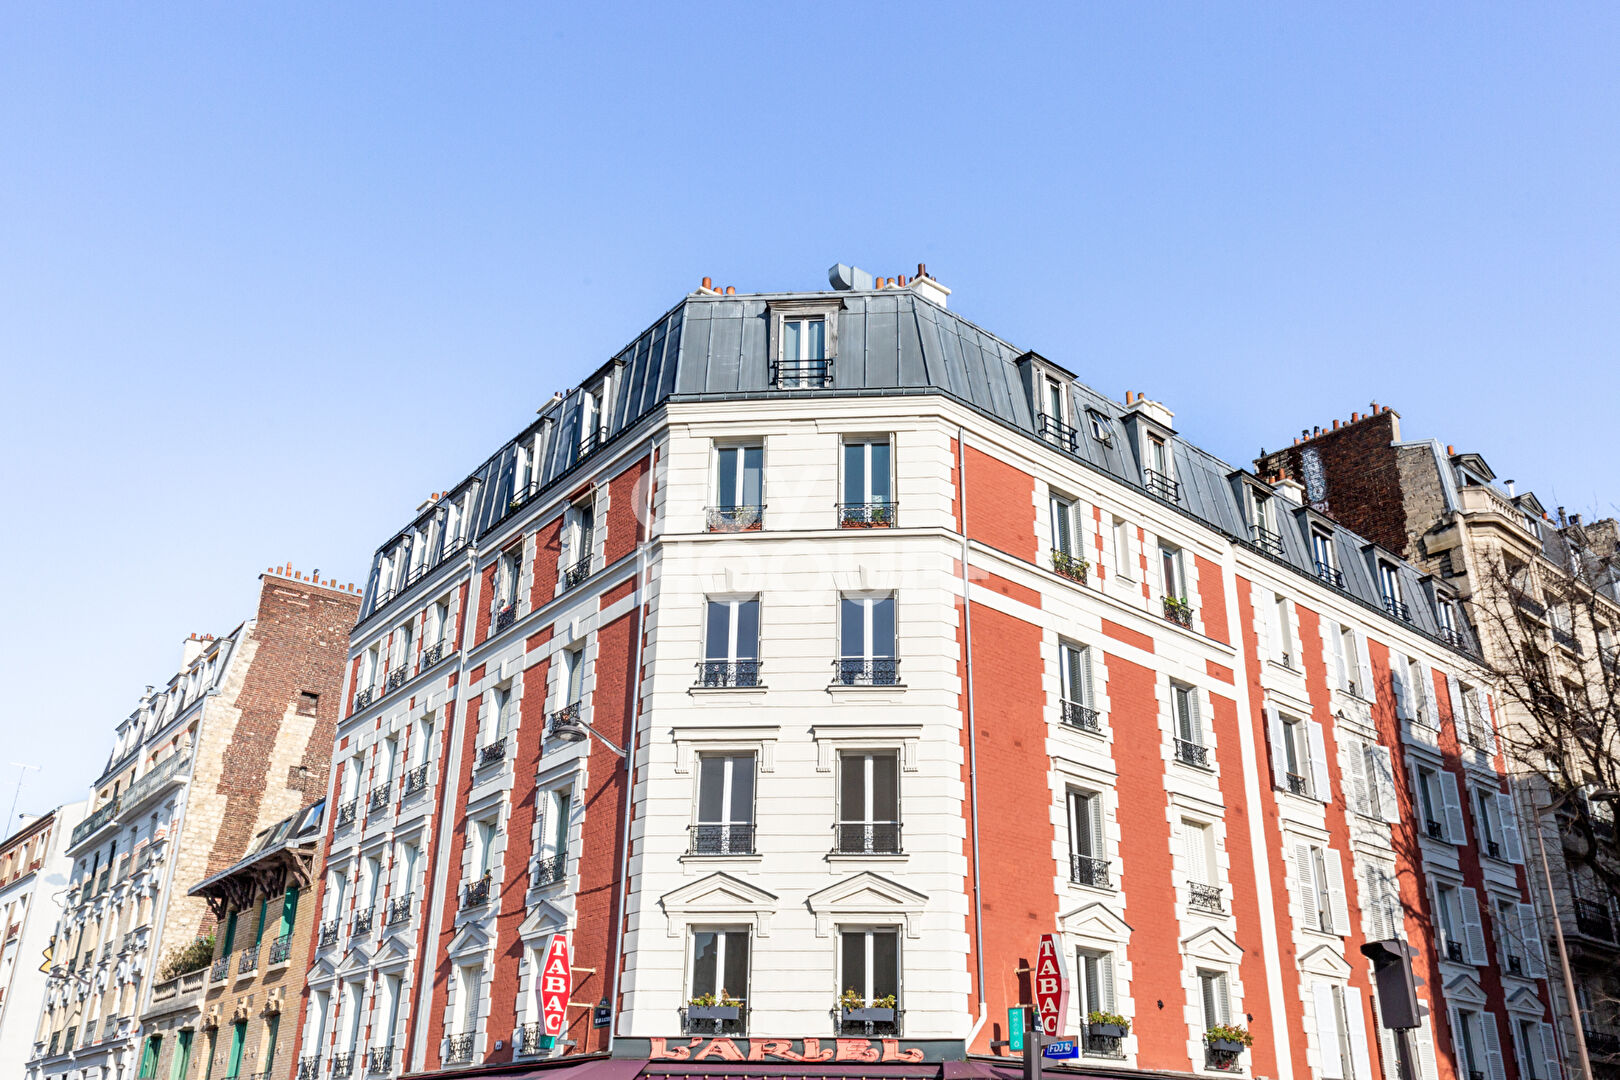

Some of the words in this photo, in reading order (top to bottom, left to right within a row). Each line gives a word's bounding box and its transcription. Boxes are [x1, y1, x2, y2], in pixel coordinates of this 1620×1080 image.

[544, 940, 568, 1031] TABAC
[1038, 940, 1059, 1033] TABAC
[1049, 1043, 1064, 1053] FDJ
